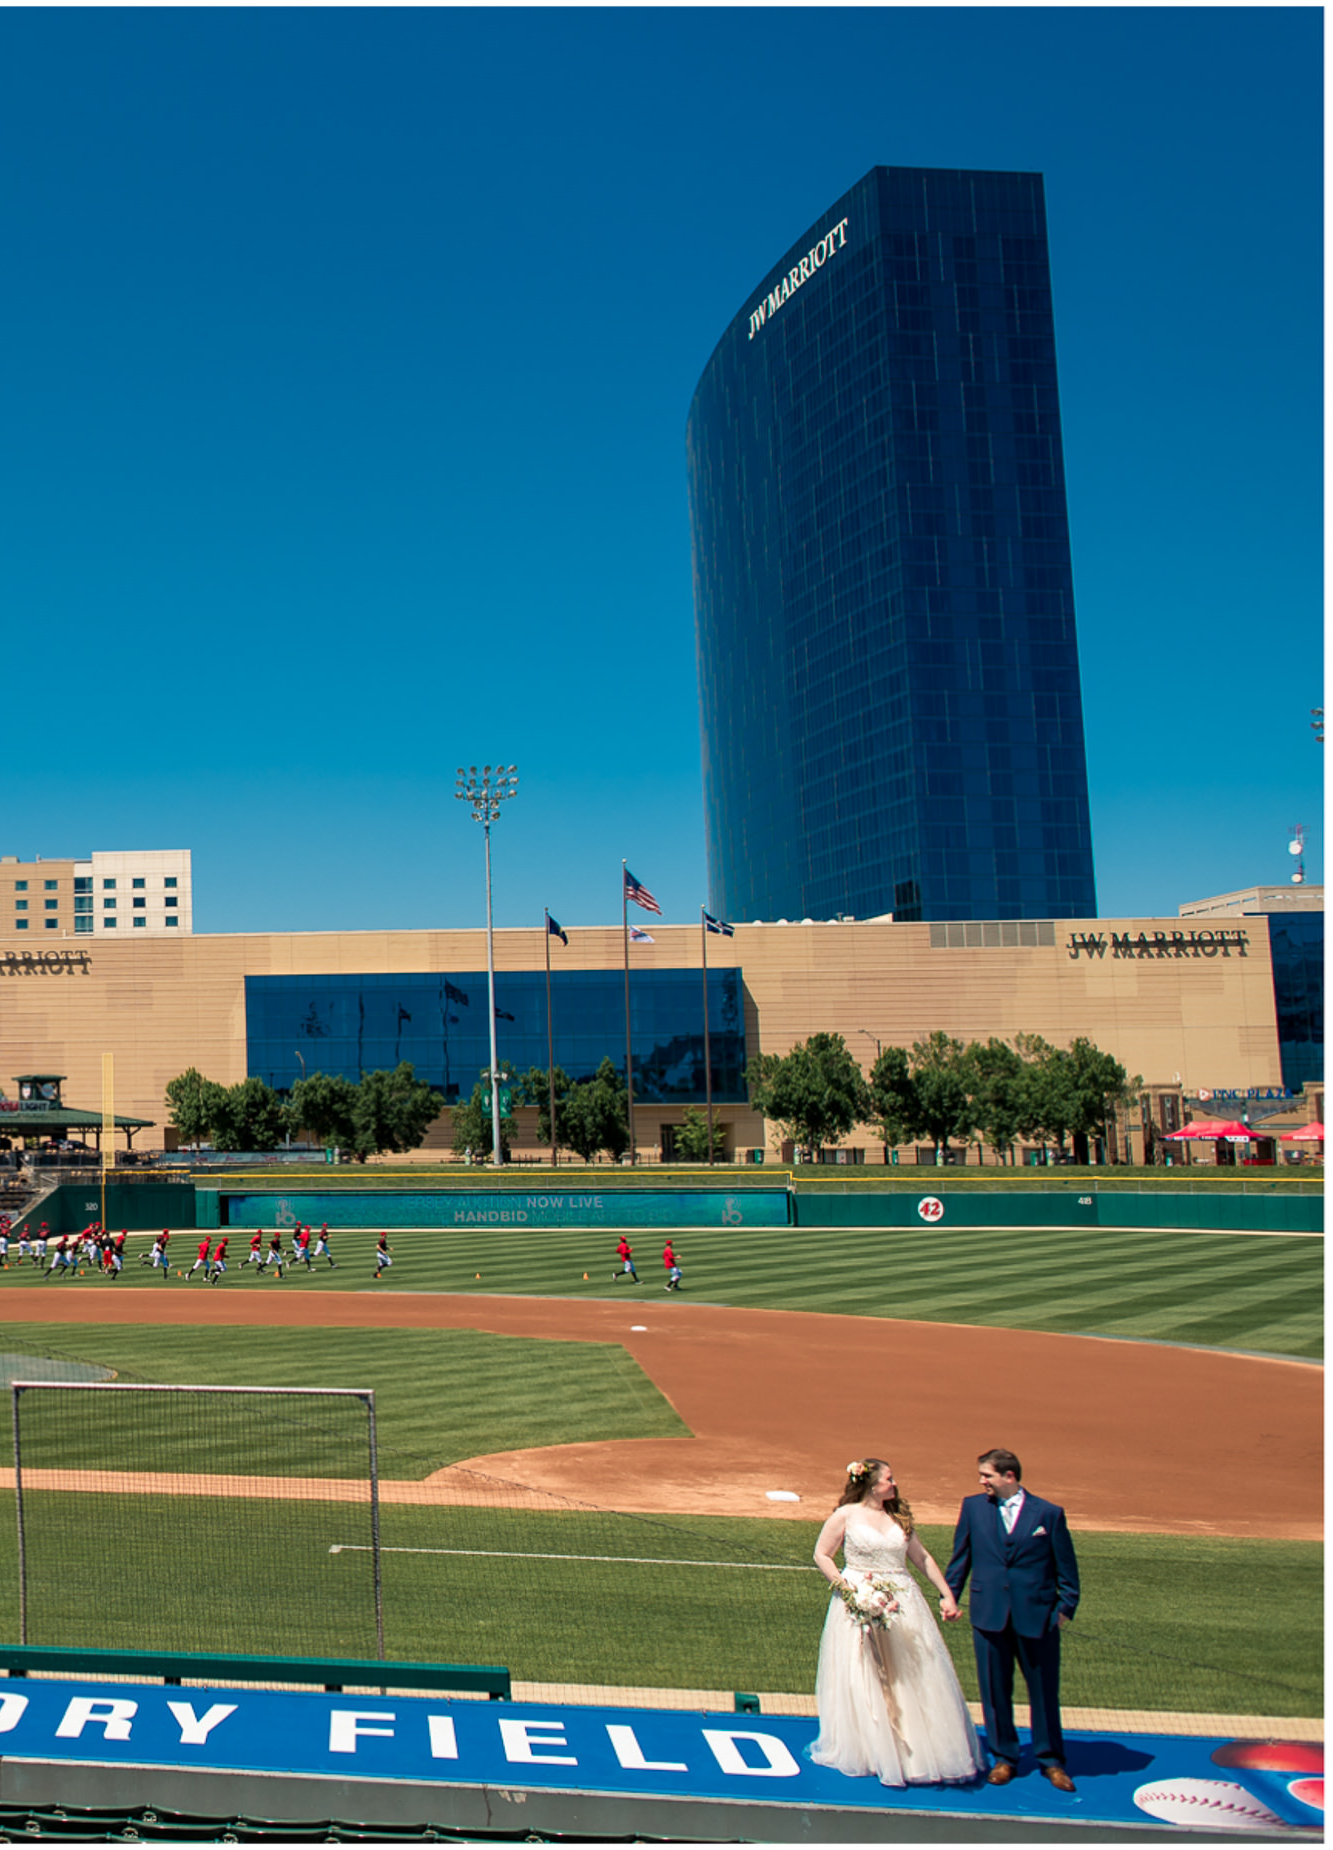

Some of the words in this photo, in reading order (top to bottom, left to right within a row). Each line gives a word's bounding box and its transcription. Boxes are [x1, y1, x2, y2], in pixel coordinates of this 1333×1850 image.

[748, 298, 768, 340] JW
[767, 217, 849, 319] MARRIOTT
[1066, 932, 1106, 951] JW
[1109, 930, 1249, 951] MARRIOTT
[1213, 1088, 1242, 1100] PNC
[1246, 1088, 1294, 1100] PLAZA
[84, 1202, 99, 1212] 320
[526, 1196, 564, 1208] NOW
[568, 1196, 604, 1208] LIVE
[919, 1201, 941, 1217] 42
[453, 1210, 529, 1223] HANDBID
[329, 1710, 801, 1777] FIELD
